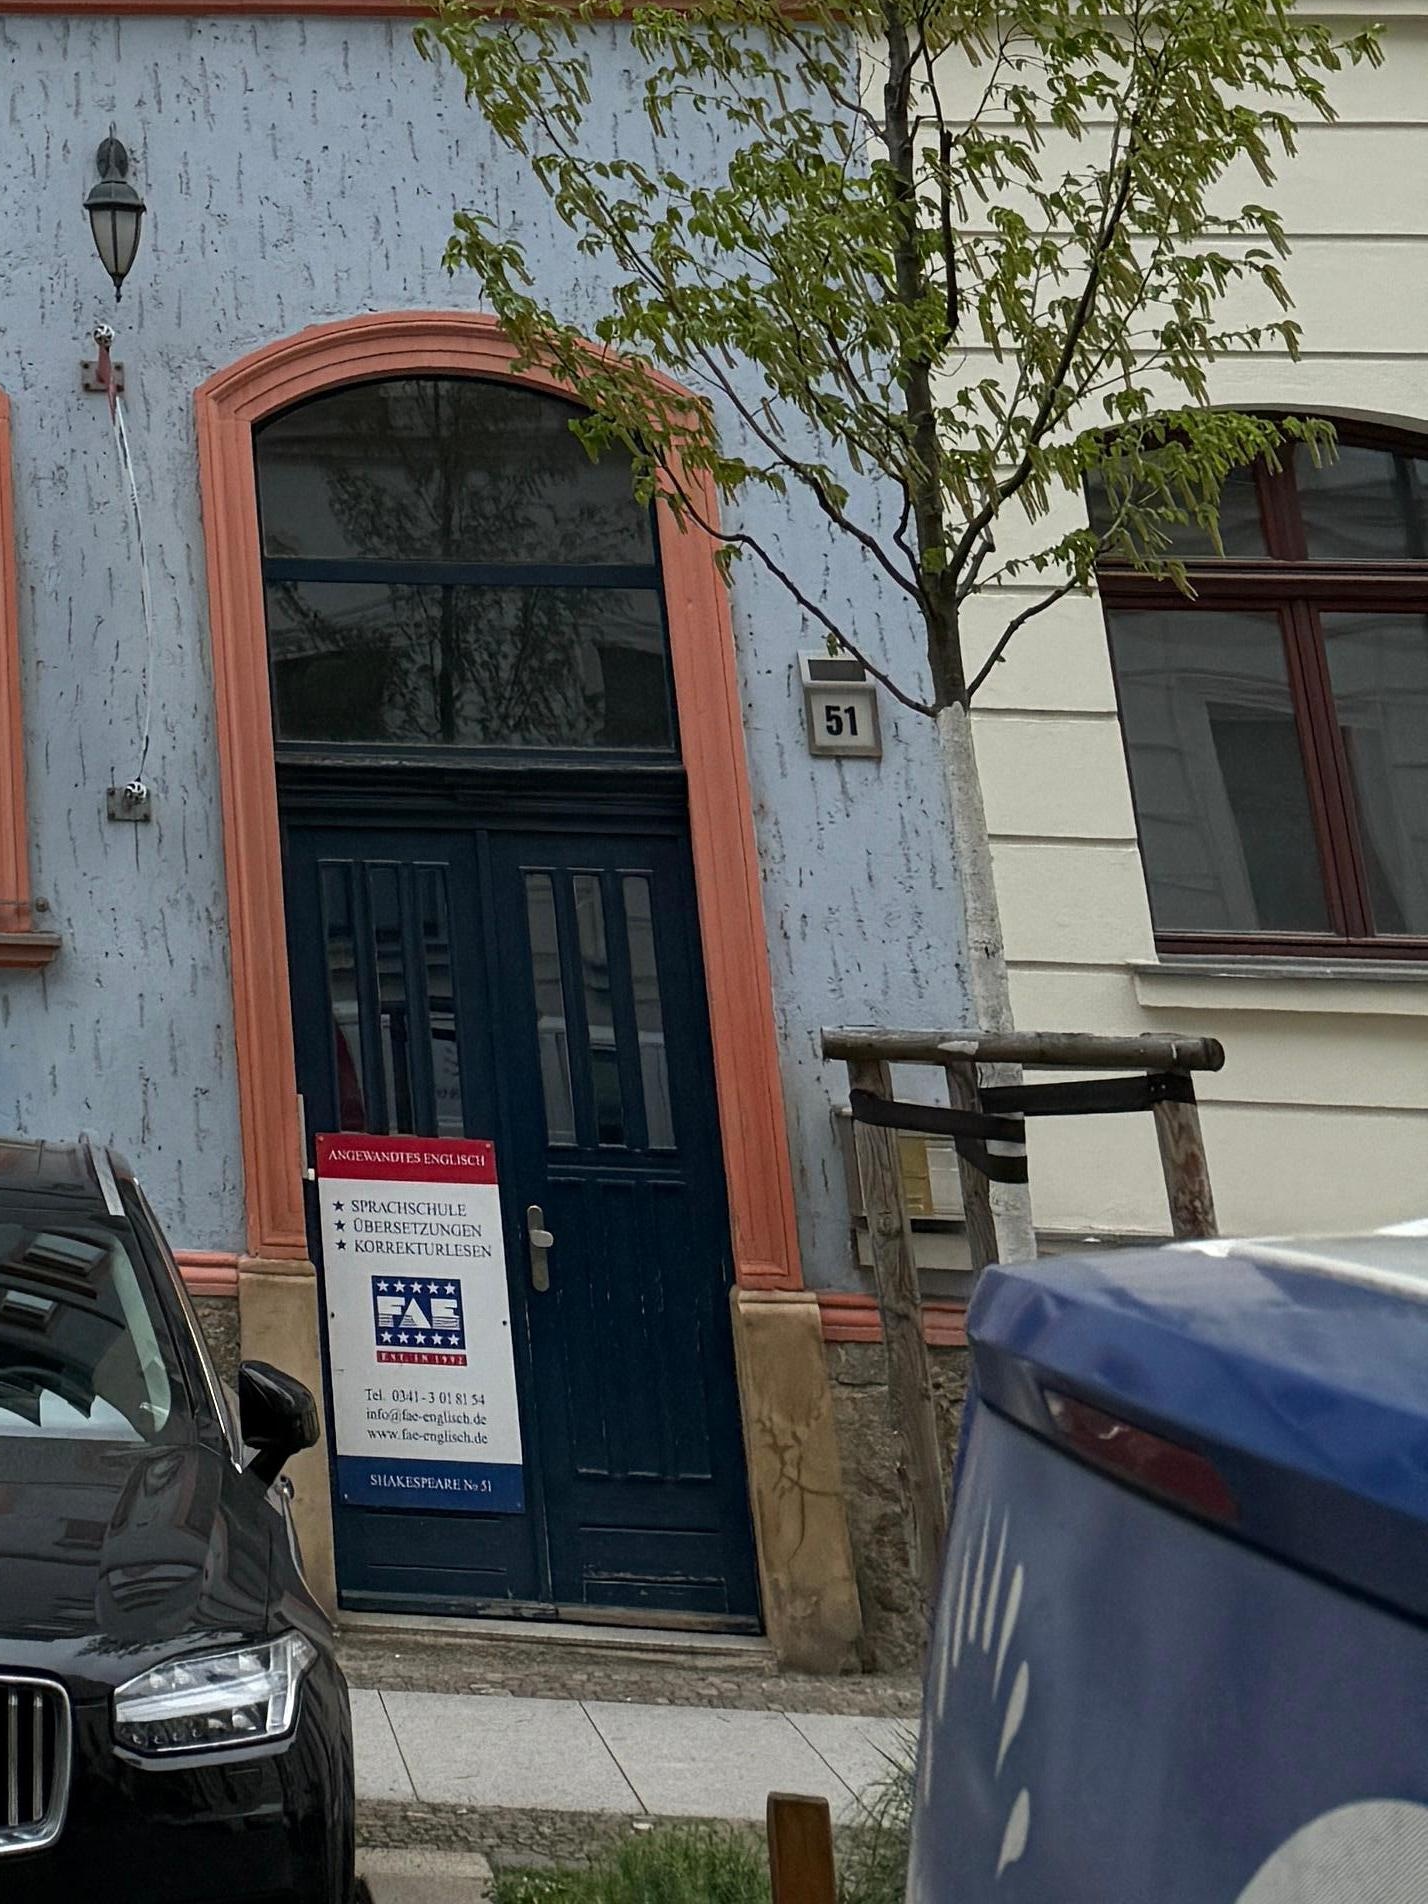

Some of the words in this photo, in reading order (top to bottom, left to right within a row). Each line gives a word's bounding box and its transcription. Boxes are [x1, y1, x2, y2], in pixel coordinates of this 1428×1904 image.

[824, 705, 858, 737] 51
[328, 1149, 421, 1165] ANGEWANDTES
[423, 1152, 485, 1167] ENGLISCH
[351, 1199, 467, 1217] SPRACHSCHULE
[353, 1217, 482, 1238] ÜBERSETZUNGEN
[354, 1239, 493, 1258] KORREKTURLESEN
[376, 1295, 461, 1331] FAE
[366, 1407, 488, 1427] info@fae-englisch.de
[367, 1428, 488, 1445] www.fae-englisch.de
[370, 1474, 461, 1491] SHAKESPEARE
